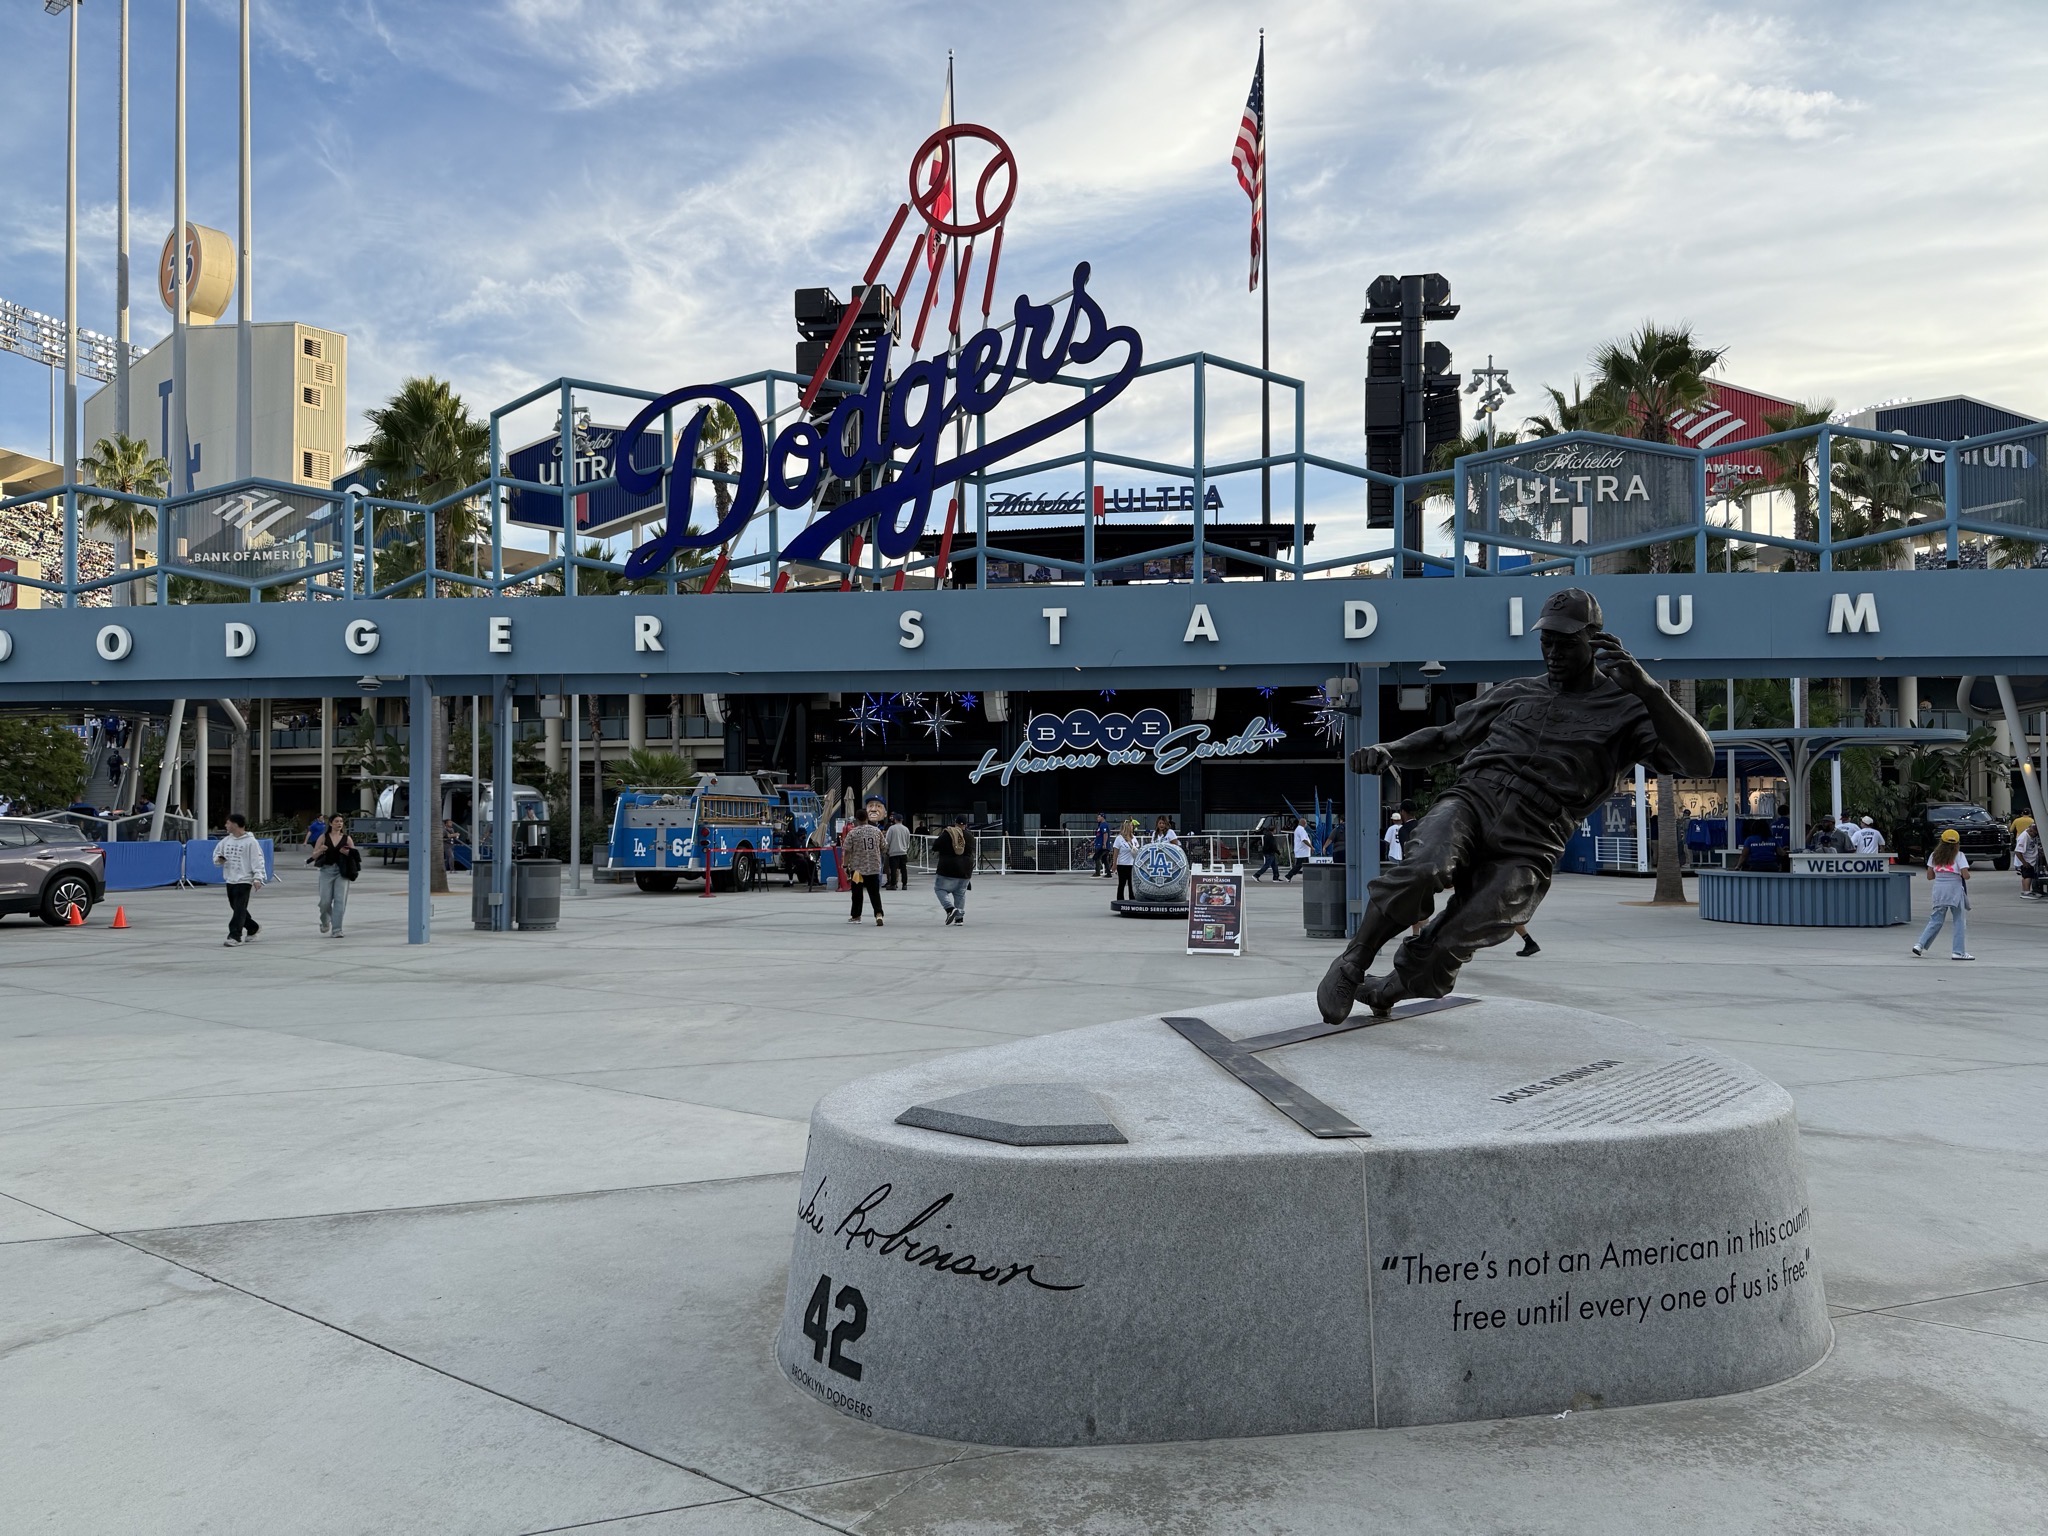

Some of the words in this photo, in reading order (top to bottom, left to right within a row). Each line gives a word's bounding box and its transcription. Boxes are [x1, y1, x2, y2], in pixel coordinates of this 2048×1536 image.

[616, 261, 1144, 580] Dodgers
[1534, 450, 1627, 472] Michelob
[1890, 430, 2028, 468] Spetrum
[989, 491, 1085, 516] Michelob
[1113, 485, 1224, 512] ULTRA
[1516, 474, 1651, 504] ULTRA
[194, 552, 230, 562] BANK
[233, 551, 251, 561] OF
[252, 550, 313, 561] AMERICA
[899, 592, 1881, 650] STADIUM
[1036, 720, 1162, 742] BLUE
[969, 740, 1101, 786] Heaven
[1107, 749, 1147, 766] on
[1153, 716, 1287, 775] Earth
[1605, 801, 1626, 833] LA
[633, 837, 646, 857] LA
[672, 838, 694, 857] 62
[863, 837, 874, 850] 13
[1863, 837, 1873, 848] 17
[1148, 847, 1172, 877] LA
[1807, 860, 1884, 873] WELCOME
[1490, 1084, 1554, 1104] JACKIE
[1540, 1059, 1625, 1086] ROBINSON
[834, 1183, 1085, 1291] Robinson
[1507, 1251, 1550, 1278] not
[1558, 1252, 1591, 1274] an
[1600, 1237, 1719, 1270] American
[1727, 1229, 1744, 1256] in
[1749, 1219, 1777, 1252] this
[1452, 1299, 1506, 1332] free
[1517, 1291, 1570, 1327] until
[1579, 1296, 1652, 1324] every
[1660, 1288, 1707, 1312] one
[1714, 1272, 1738, 1305] of
[1743, 1279, 1763, 1300] us
[1767, 1268, 1778, 1293] is
[803, 1273, 868, 1382] 42
[791, 1362, 825, 1397] BROOKLYN
[827, 1387, 873, 1418] DODGERS
